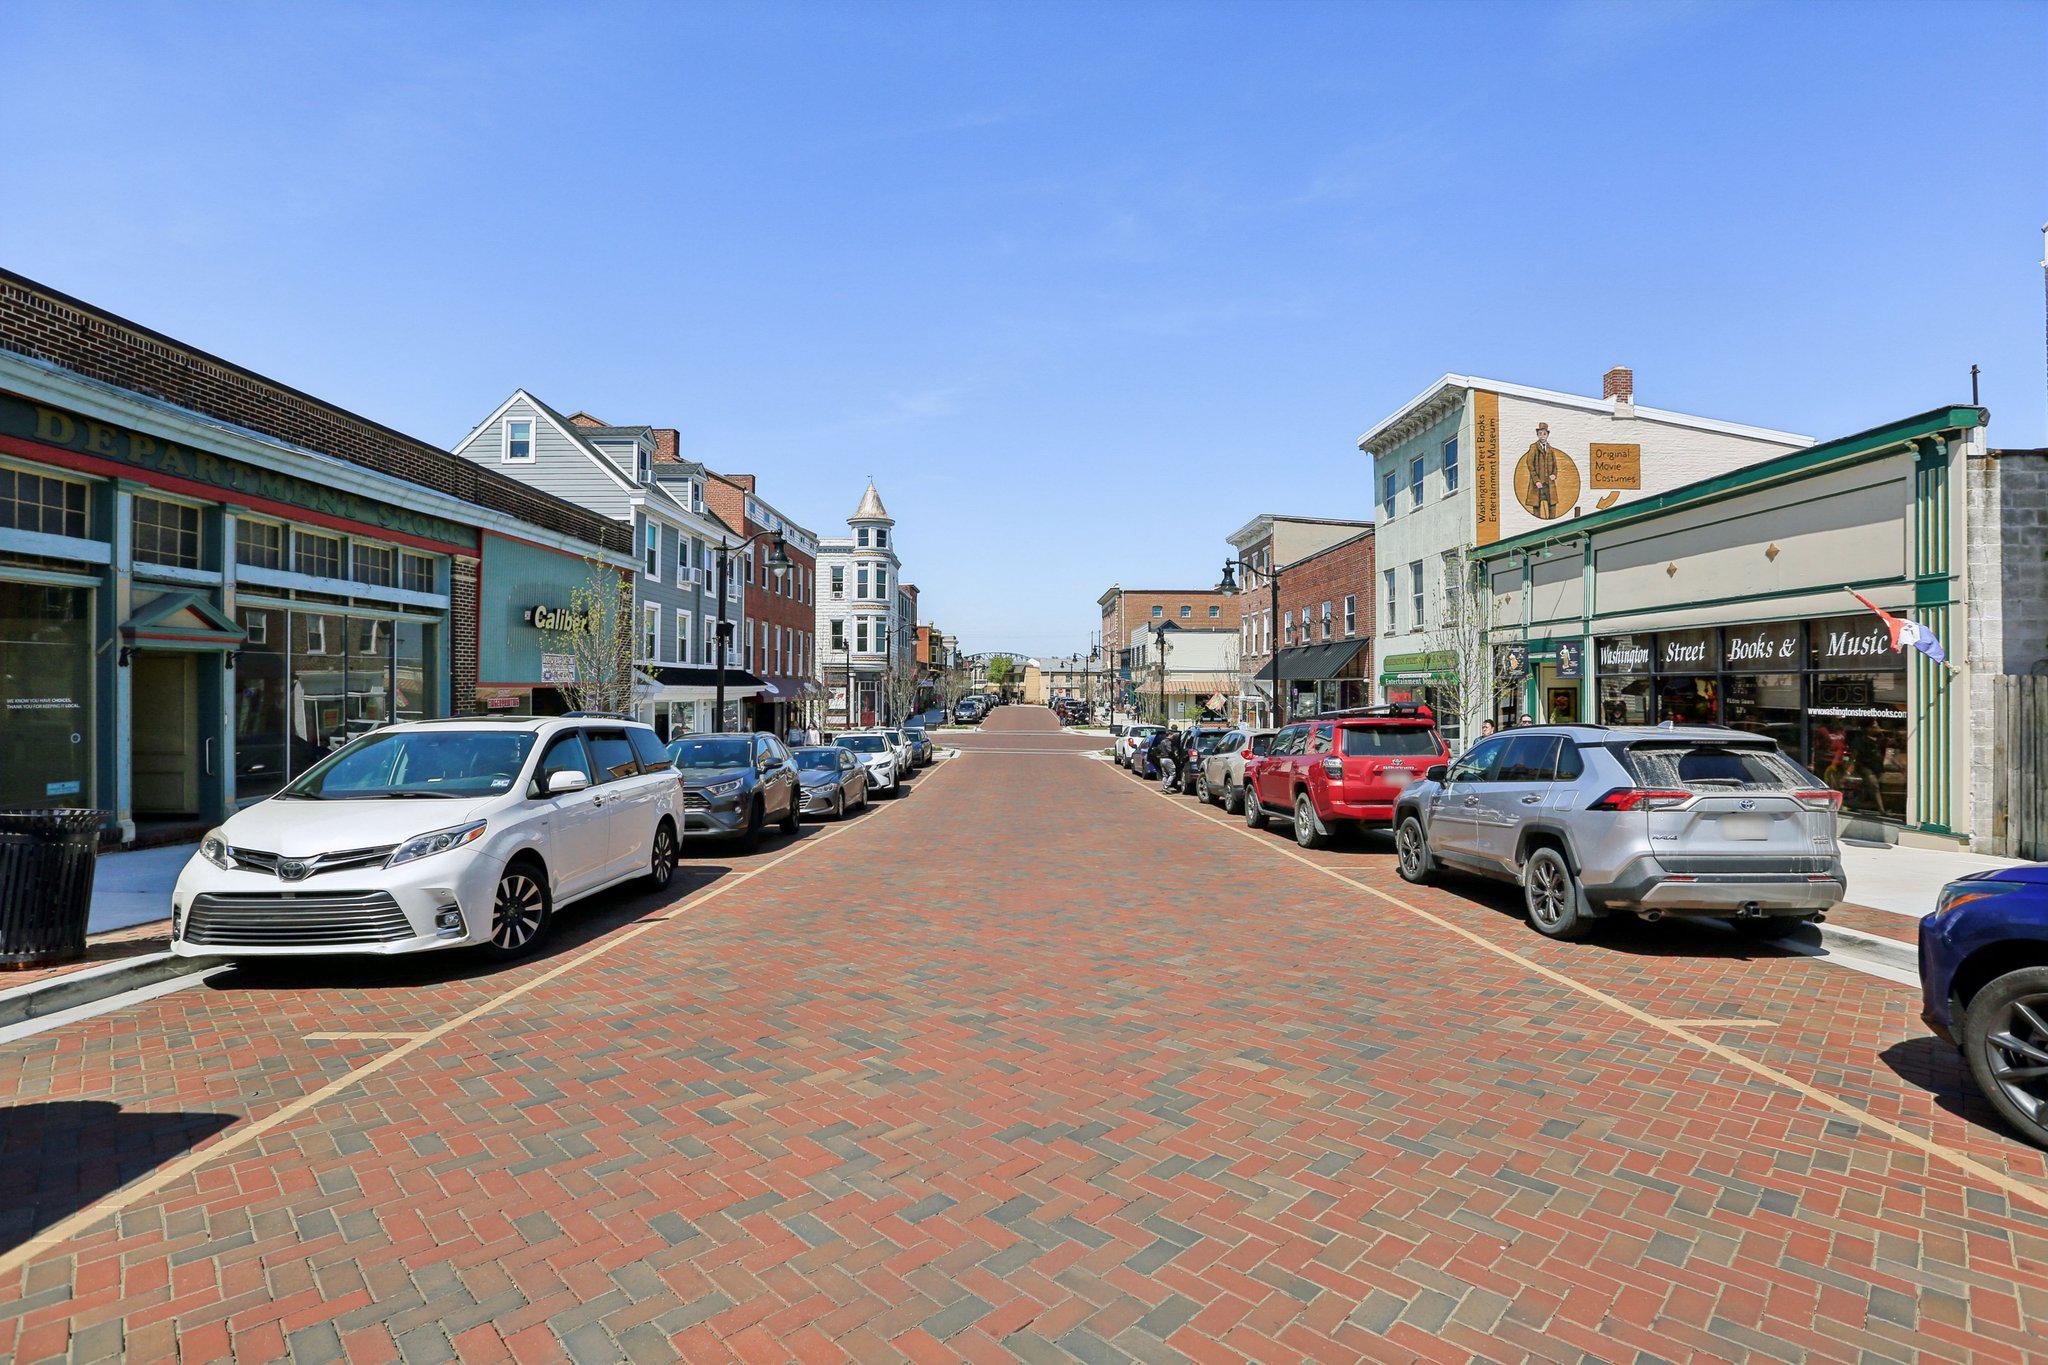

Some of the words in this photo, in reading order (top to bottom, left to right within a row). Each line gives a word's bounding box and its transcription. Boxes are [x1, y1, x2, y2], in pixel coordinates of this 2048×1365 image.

[1476, 414, 1486, 443] Books
[1487, 418, 1497, 459] Museum
[1477, 445, 1486, 472] Street
[1595, 448, 1630, 461] Original
[1595, 461, 1621, 471] Movie
[32, 406, 360, 519] DEPARTMENT
[376, 504, 462, 545] STORE
[1595, 472, 1636, 484] Costumes
[1478, 474, 1488, 523] Washington
[1488, 460, 1497, 523] Entertainment
[534, 605, 589, 633] Caliber
[1600, 644, 1649, 673] Washington
[1666, 640, 1706, 662] Street
[1730, 632, 1774, 660] Books
[1779, 638, 1796, 659] &
[1826, 628, 1888, 657] Music
